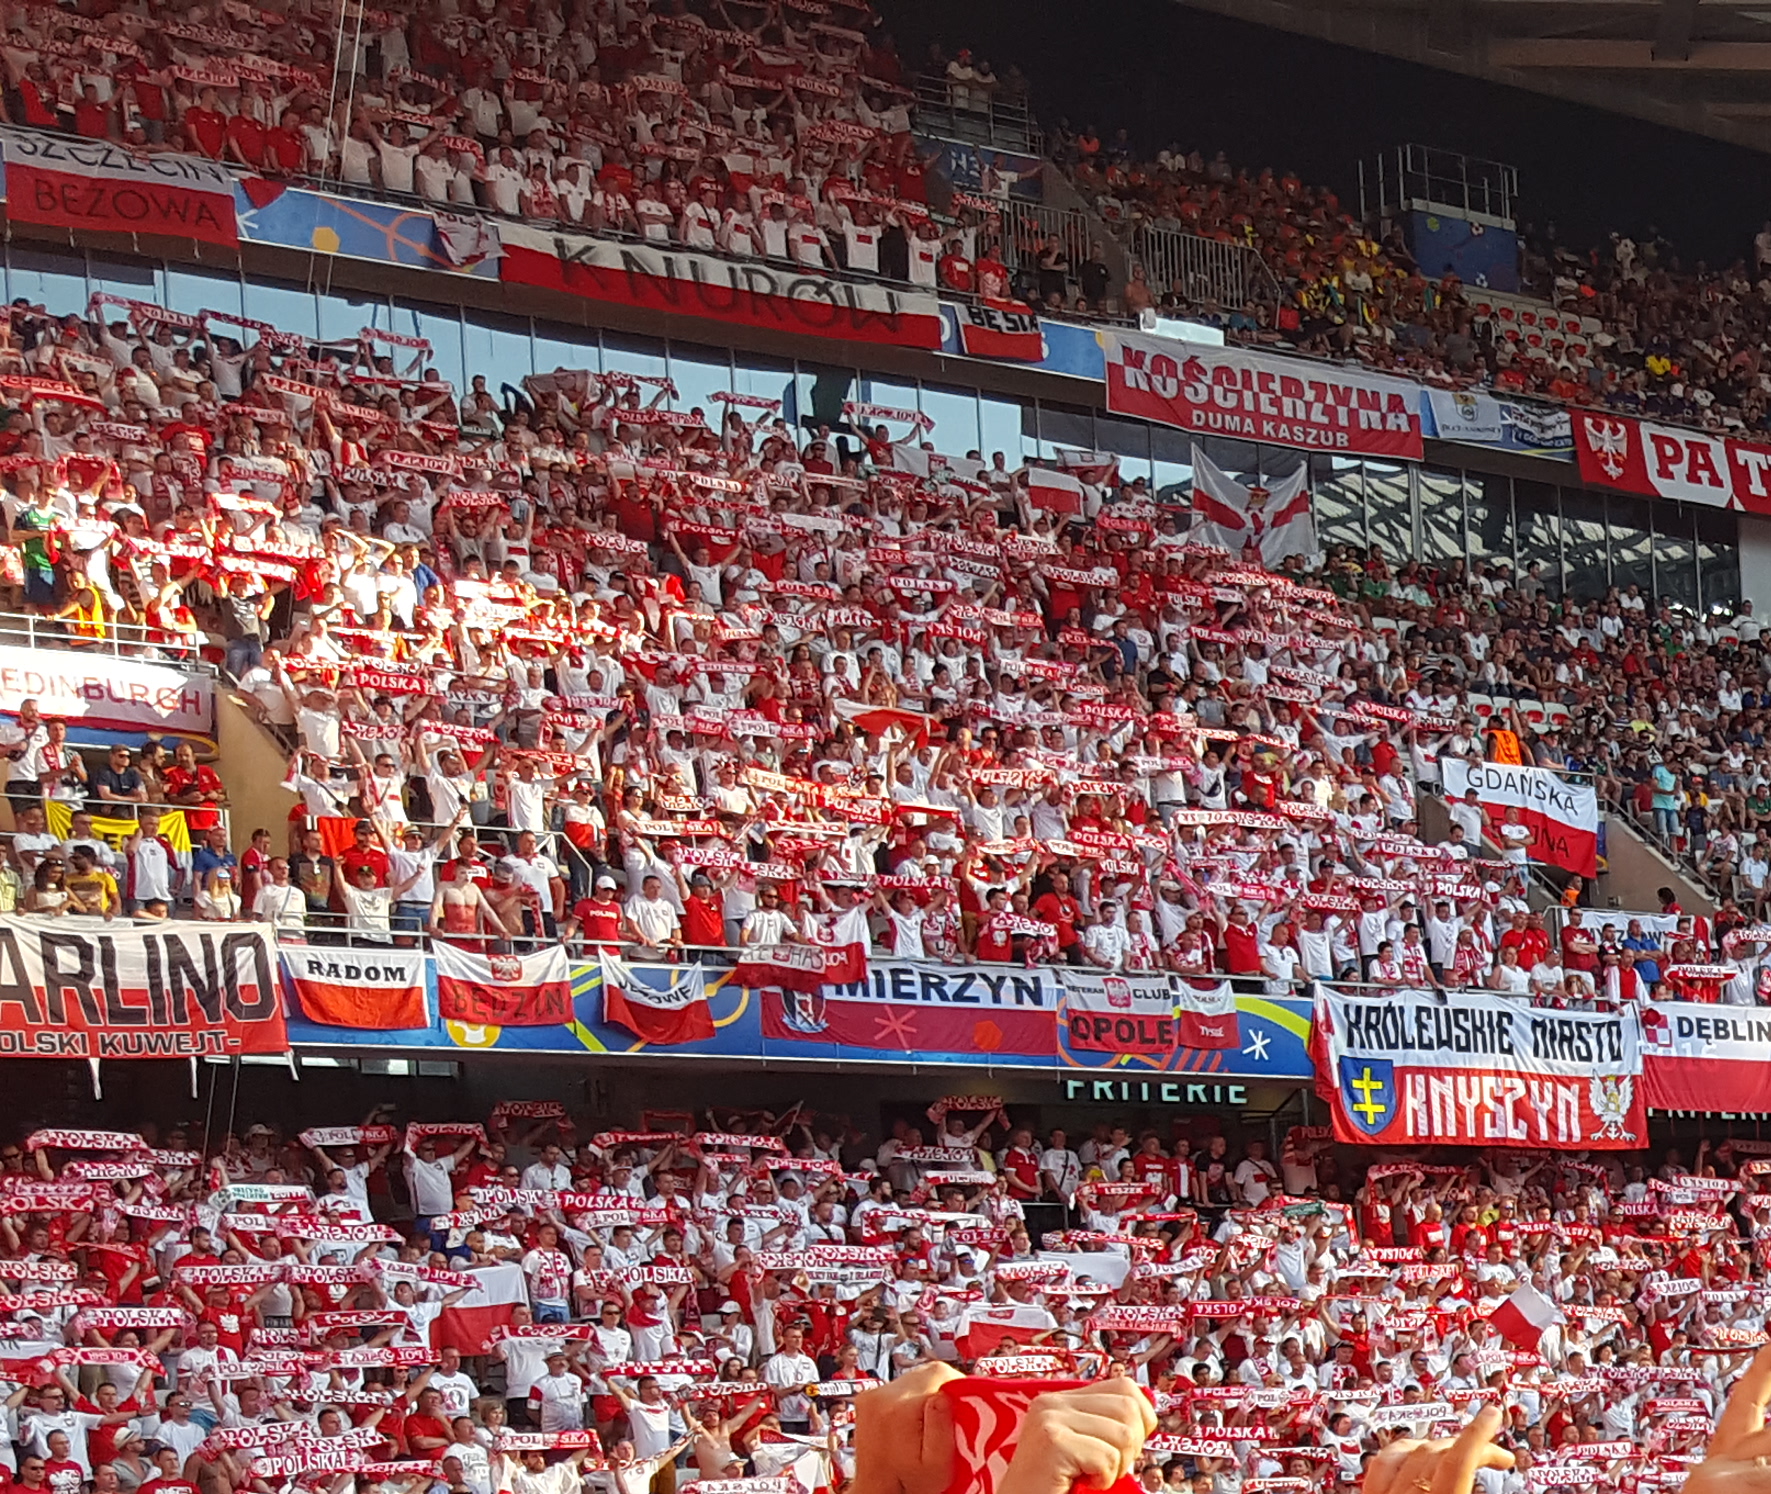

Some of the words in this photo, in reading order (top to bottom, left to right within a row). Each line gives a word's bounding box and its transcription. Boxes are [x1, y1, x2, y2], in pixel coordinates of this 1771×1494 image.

[1122, 345, 1411, 432] KOŚCIERZYNA
[1191, 409, 1256, 436] DUMA
[1262, 420, 1350, 448] KASZUB
[1, 666, 202, 716] EDINBURGH
[358, 672, 422, 690] POLSKA
[1466, 766, 1578, 817] GDAŃSKA
[1436, 881, 1482, 899] POLSKA
[307, 960, 406, 982] RADOM
[835, 966, 1044, 1007] MIERZYN
[1132, 988, 1171, 1001] CLUB
[1069, 1017, 1174, 1046] OPOLE
[1343, 1003, 1514, 1055] KRÓLEWSKIE
[1530, 1018, 1623, 1063] MIASTO
[1405, 1073, 1580, 1143] KNYSZYN
[55, 1131, 140, 1149] POLSKA
[564, 1194, 630, 1210] POLSKA
[100, 1310, 178, 1327] POLSKA
[1206, 1425, 1267, 1439] POLSKA
[272, 1444, 347, 1466] POLSKA
